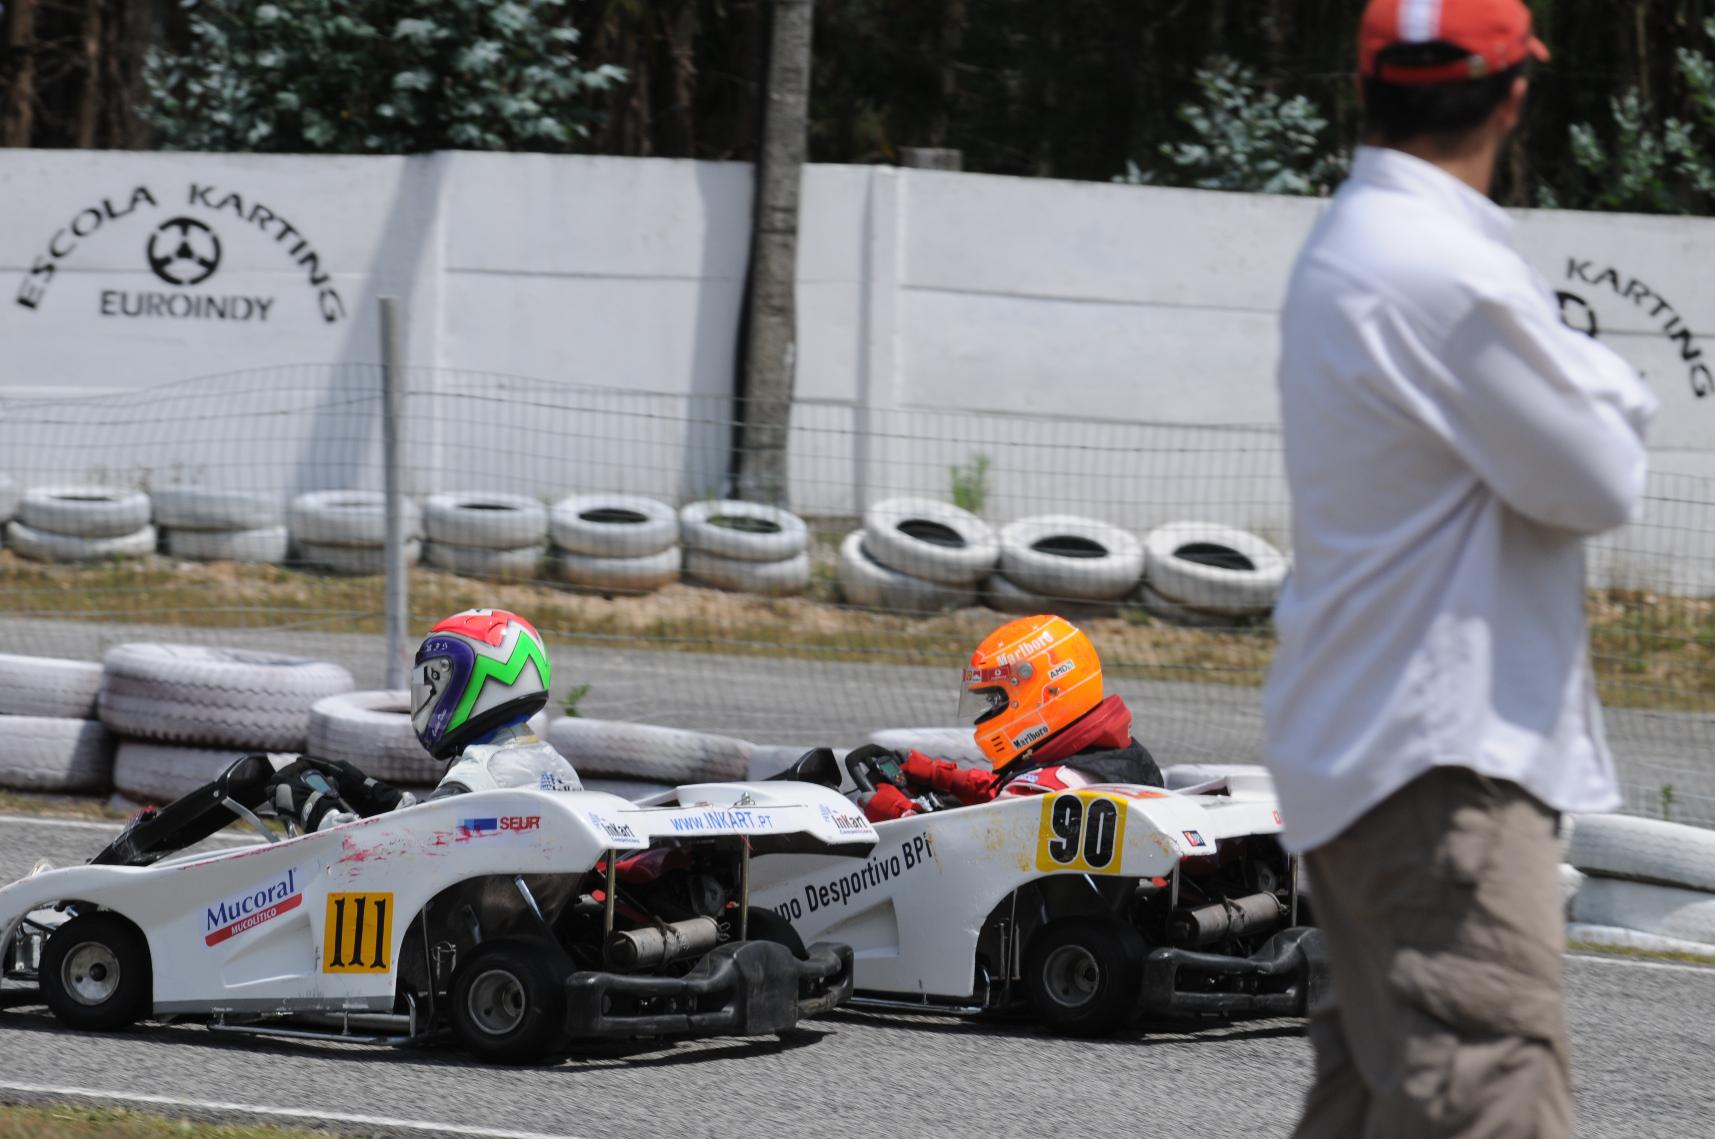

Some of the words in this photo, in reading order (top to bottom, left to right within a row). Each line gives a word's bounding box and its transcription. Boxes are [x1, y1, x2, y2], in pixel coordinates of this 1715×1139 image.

[16, 184, 158, 312] ESCOLA
[189, 182, 347, 324] KARTING
[99, 289, 276, 322] EUROINDY
[1566, 257, 1715, 398] KARTING
[996, 629, 1054, 667] Marlboro
[1013, 725, 1049, 750] Marlboro
[500, 815, 541, 831] SEUR
[1049, 794, 1118, 869] 90
[206, 868, 296, 931] Mucoral
[804, 855, 901, 913] Desportivo
[231, 906, 277, 936] MUCOLÍTICO
[329, 896, 387, 969] 111
